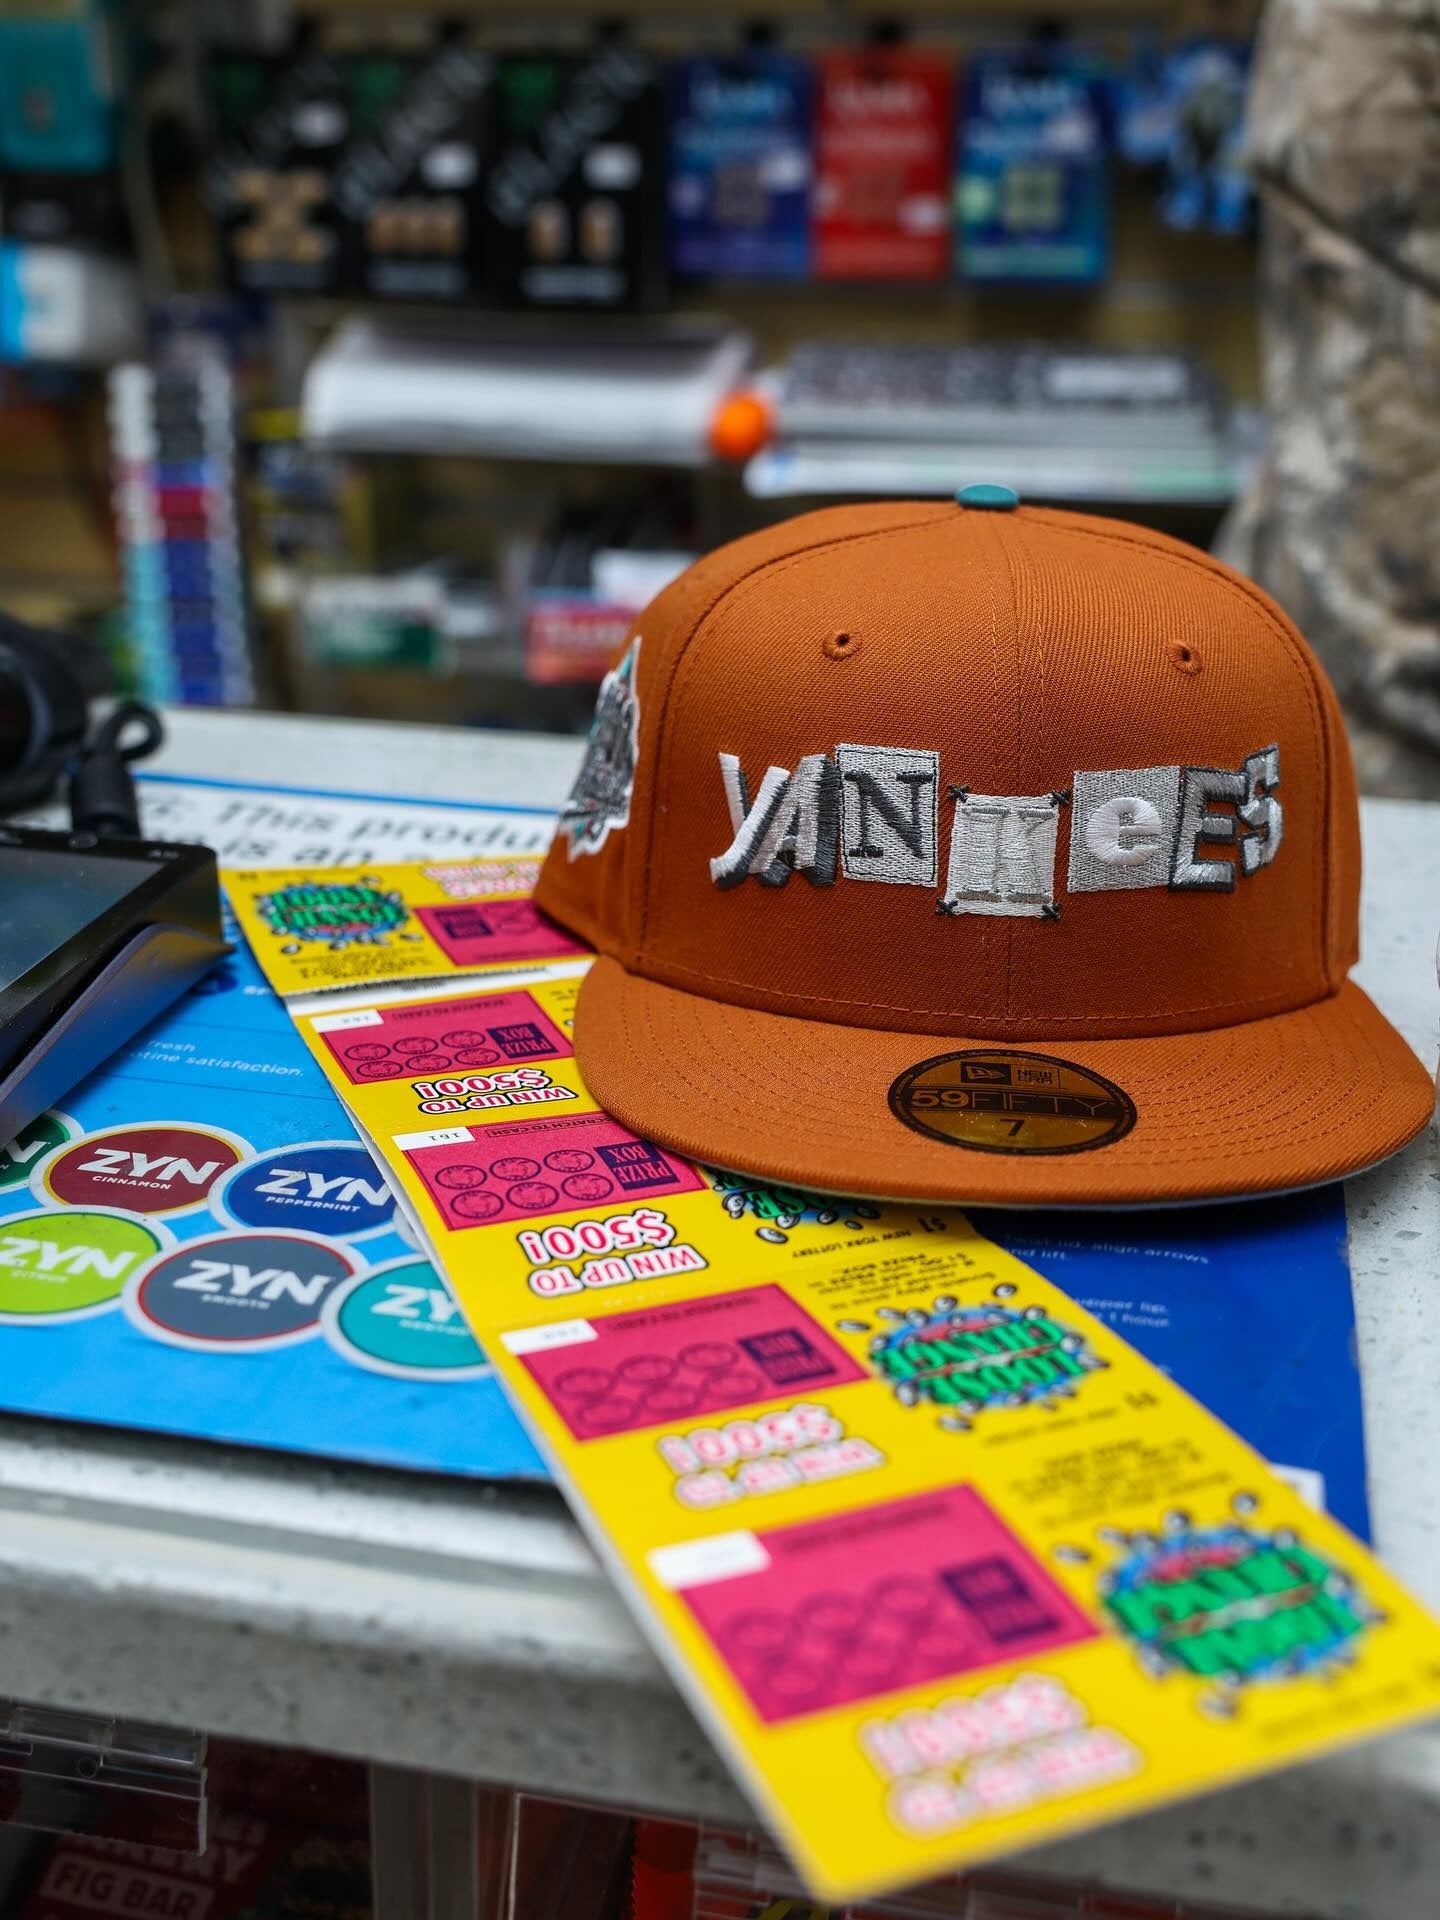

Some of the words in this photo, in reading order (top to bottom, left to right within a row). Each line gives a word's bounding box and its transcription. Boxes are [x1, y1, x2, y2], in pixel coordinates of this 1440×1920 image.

[351, 815, 545, 852] produ
[496, 1027, 532, 1041] BOX
[500, 1038, 552, 1055] PRIZE
[185, 1054, 305, 1078] satisfaction.
[1016, 1069, 1054, 1079] NEW
[418, 1069, 545, 1098] $500!
[1016, 1077, 1054, 1086] ERA
[469, 1095, 507, 1109] UP
[510, 1086, 570, 1105] WIN
[911, 1090, 1118, 1117] 59FIFTY
[424, 1099, 461, 1115] TO
[491, 1125, 529, 1137] CASH
[531, 1122, 548, 1132] TO
[999, 1118, 1026, 1137] 7
[605, 1143, 650, 1163] BOX
[77, 1147, 221, 1186] ZYN
[611, 1159, 672, 1187] PRIZE
[92, 1175, 173, 1190] CINNAMON
[253, 1167, 394, 1207] ZYN
[265, 1195, 361, 1213] PEPPERMINT
[525, 1210, 669, 1262] $500!
[846, 1236, 878, 1250] YORK
[0, 1236, 136, 1280] ZYN
[791, 1242, 843, 1260] LOTTERY
[1143, 1246, 1210, 1266] arrows
[630, 1247, 699, 1277] WIN
[172, 1259, 331, 1307] ZYN
[534, 1269, 575, 1294] TO
[585, 1259, 627, 1287] UP
[370, 1283, 459, 1324] ZY
[53, 1863, 116, 1903] FIG
[122, 1879, 198, 1920] BAR
